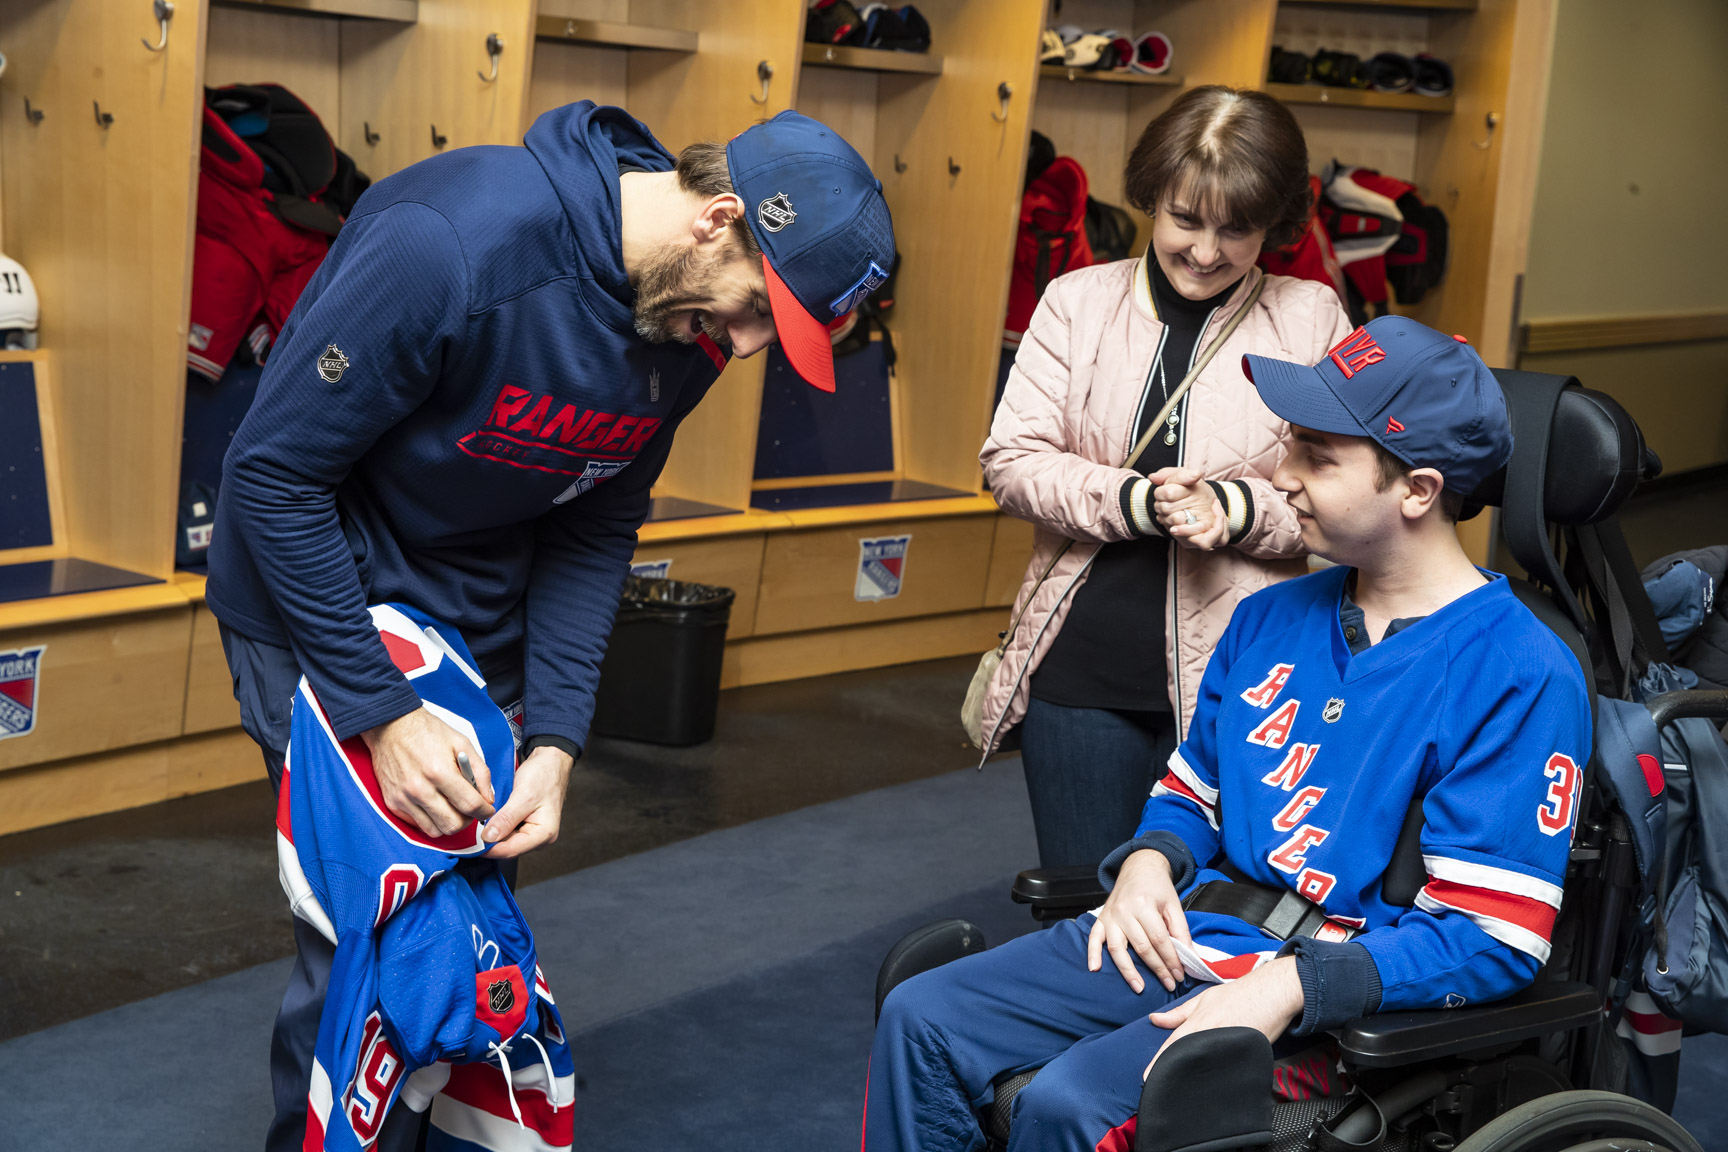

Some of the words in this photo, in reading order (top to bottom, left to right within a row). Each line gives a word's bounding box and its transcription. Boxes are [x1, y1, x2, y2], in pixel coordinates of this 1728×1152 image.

[764, 205, 788, 221] NHL
[322, 360, 342, 369] NHL
[478, 440, 530, 459] HOCKEY
[585, 467, 603, 477] NEW
[1326, 704, 1340, 717] NHL
[1240, 663, 1366, 929] RANGER
[494, 987, 509, 1008] NHL
